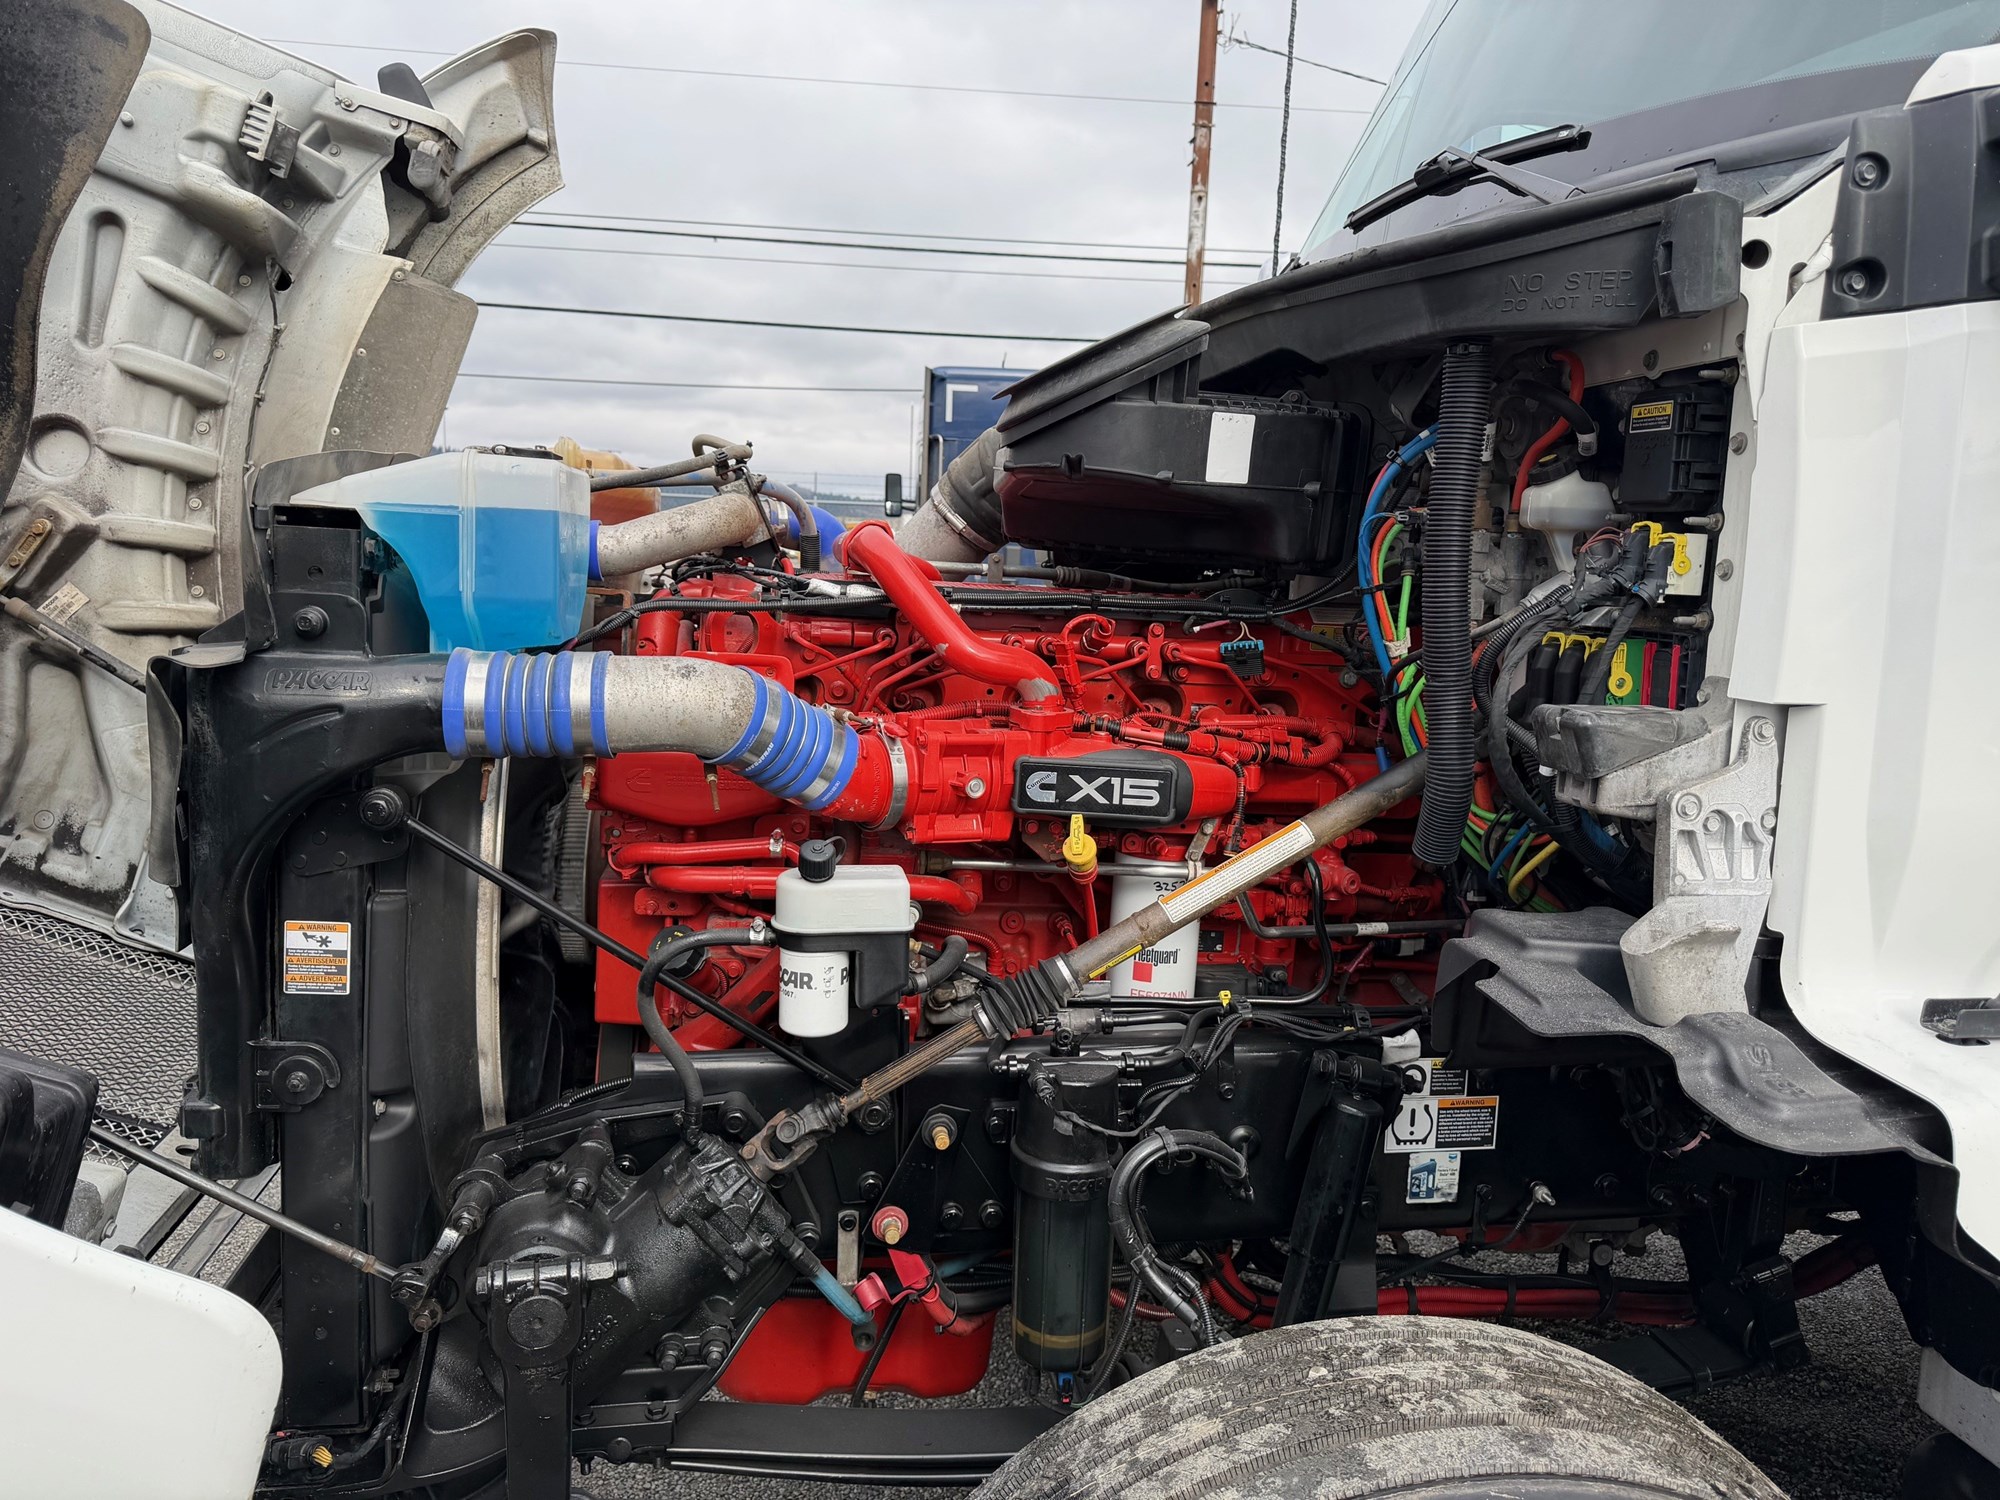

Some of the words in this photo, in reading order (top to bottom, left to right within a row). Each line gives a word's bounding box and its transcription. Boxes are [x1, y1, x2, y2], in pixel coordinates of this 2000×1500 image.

[1504, 273, 1545, 294] NO
[1564, 269, 1633, 290] STEP
[1501, 298, 1529, 312] DO
[1541, 294, 1580, 310] NOT
[1592, 293, 1637, 308] PULL
[1643, 405, 1667, 415] CAUTION
[271, 669, 370, 691] PACCAR
[1065, 774, 1160, 807] X15
[296, 957, 346, 965] AVERTISSEMENT
[298, 974, 343, 982] ADVERTENCIA
